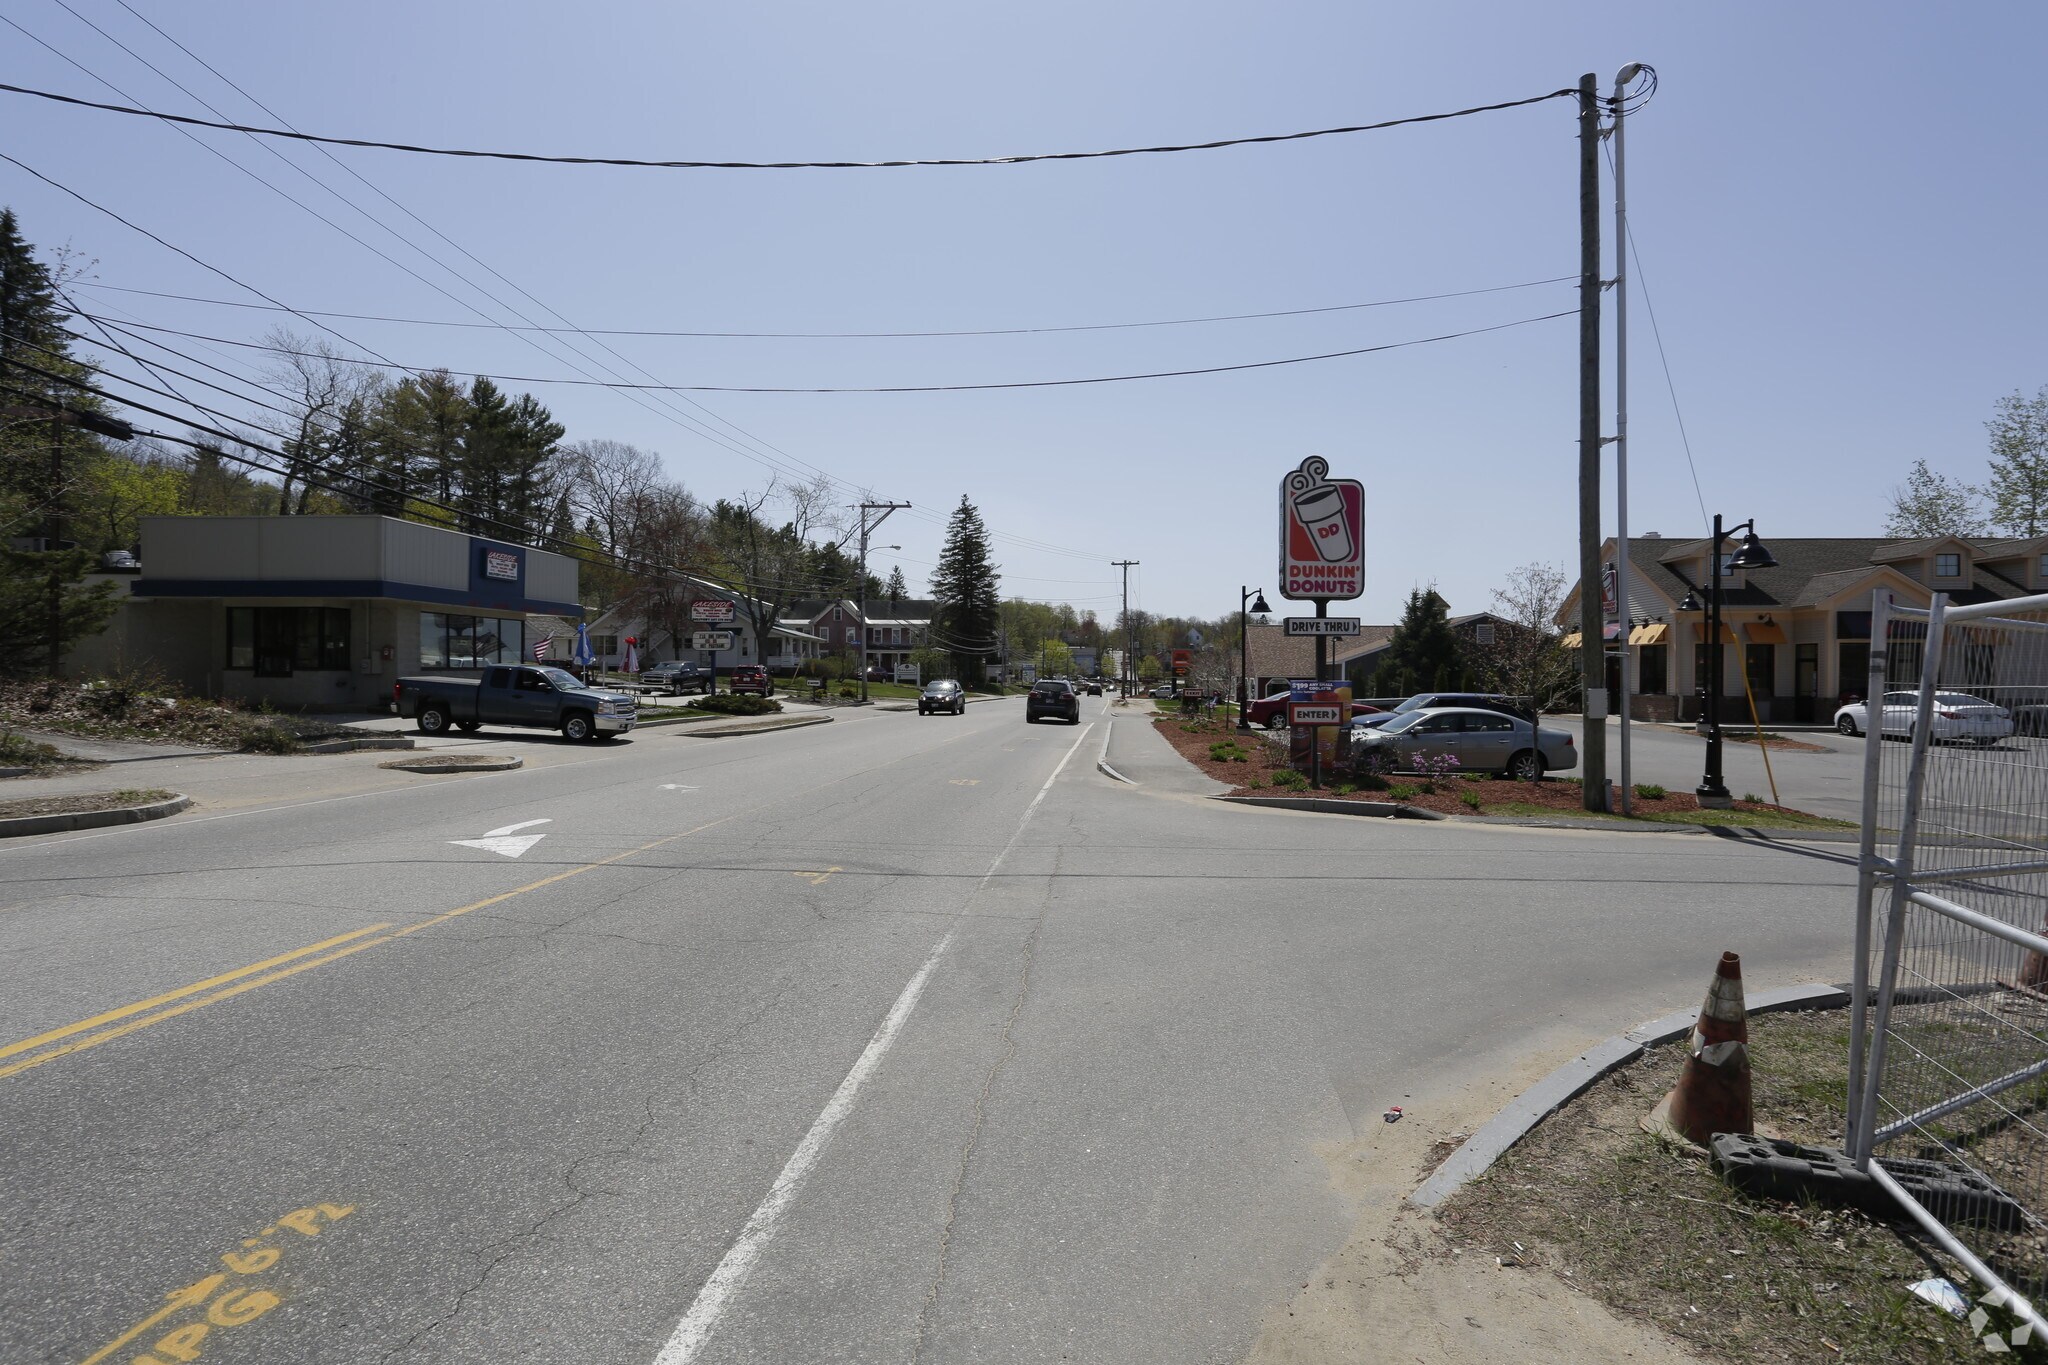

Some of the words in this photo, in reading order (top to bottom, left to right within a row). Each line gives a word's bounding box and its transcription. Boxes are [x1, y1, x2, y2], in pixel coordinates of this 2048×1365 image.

[1317, 523, 1339, 538] DD
[1290, 565, 1360, 578] DUNKIN'
[1289, 580, 1357, 593] DONUTS
[1291, 621, 1321, 632] DRIVE
[1324, 621, 1350, 632] THRU
[1296, 710, 1330, 719] ENTER
